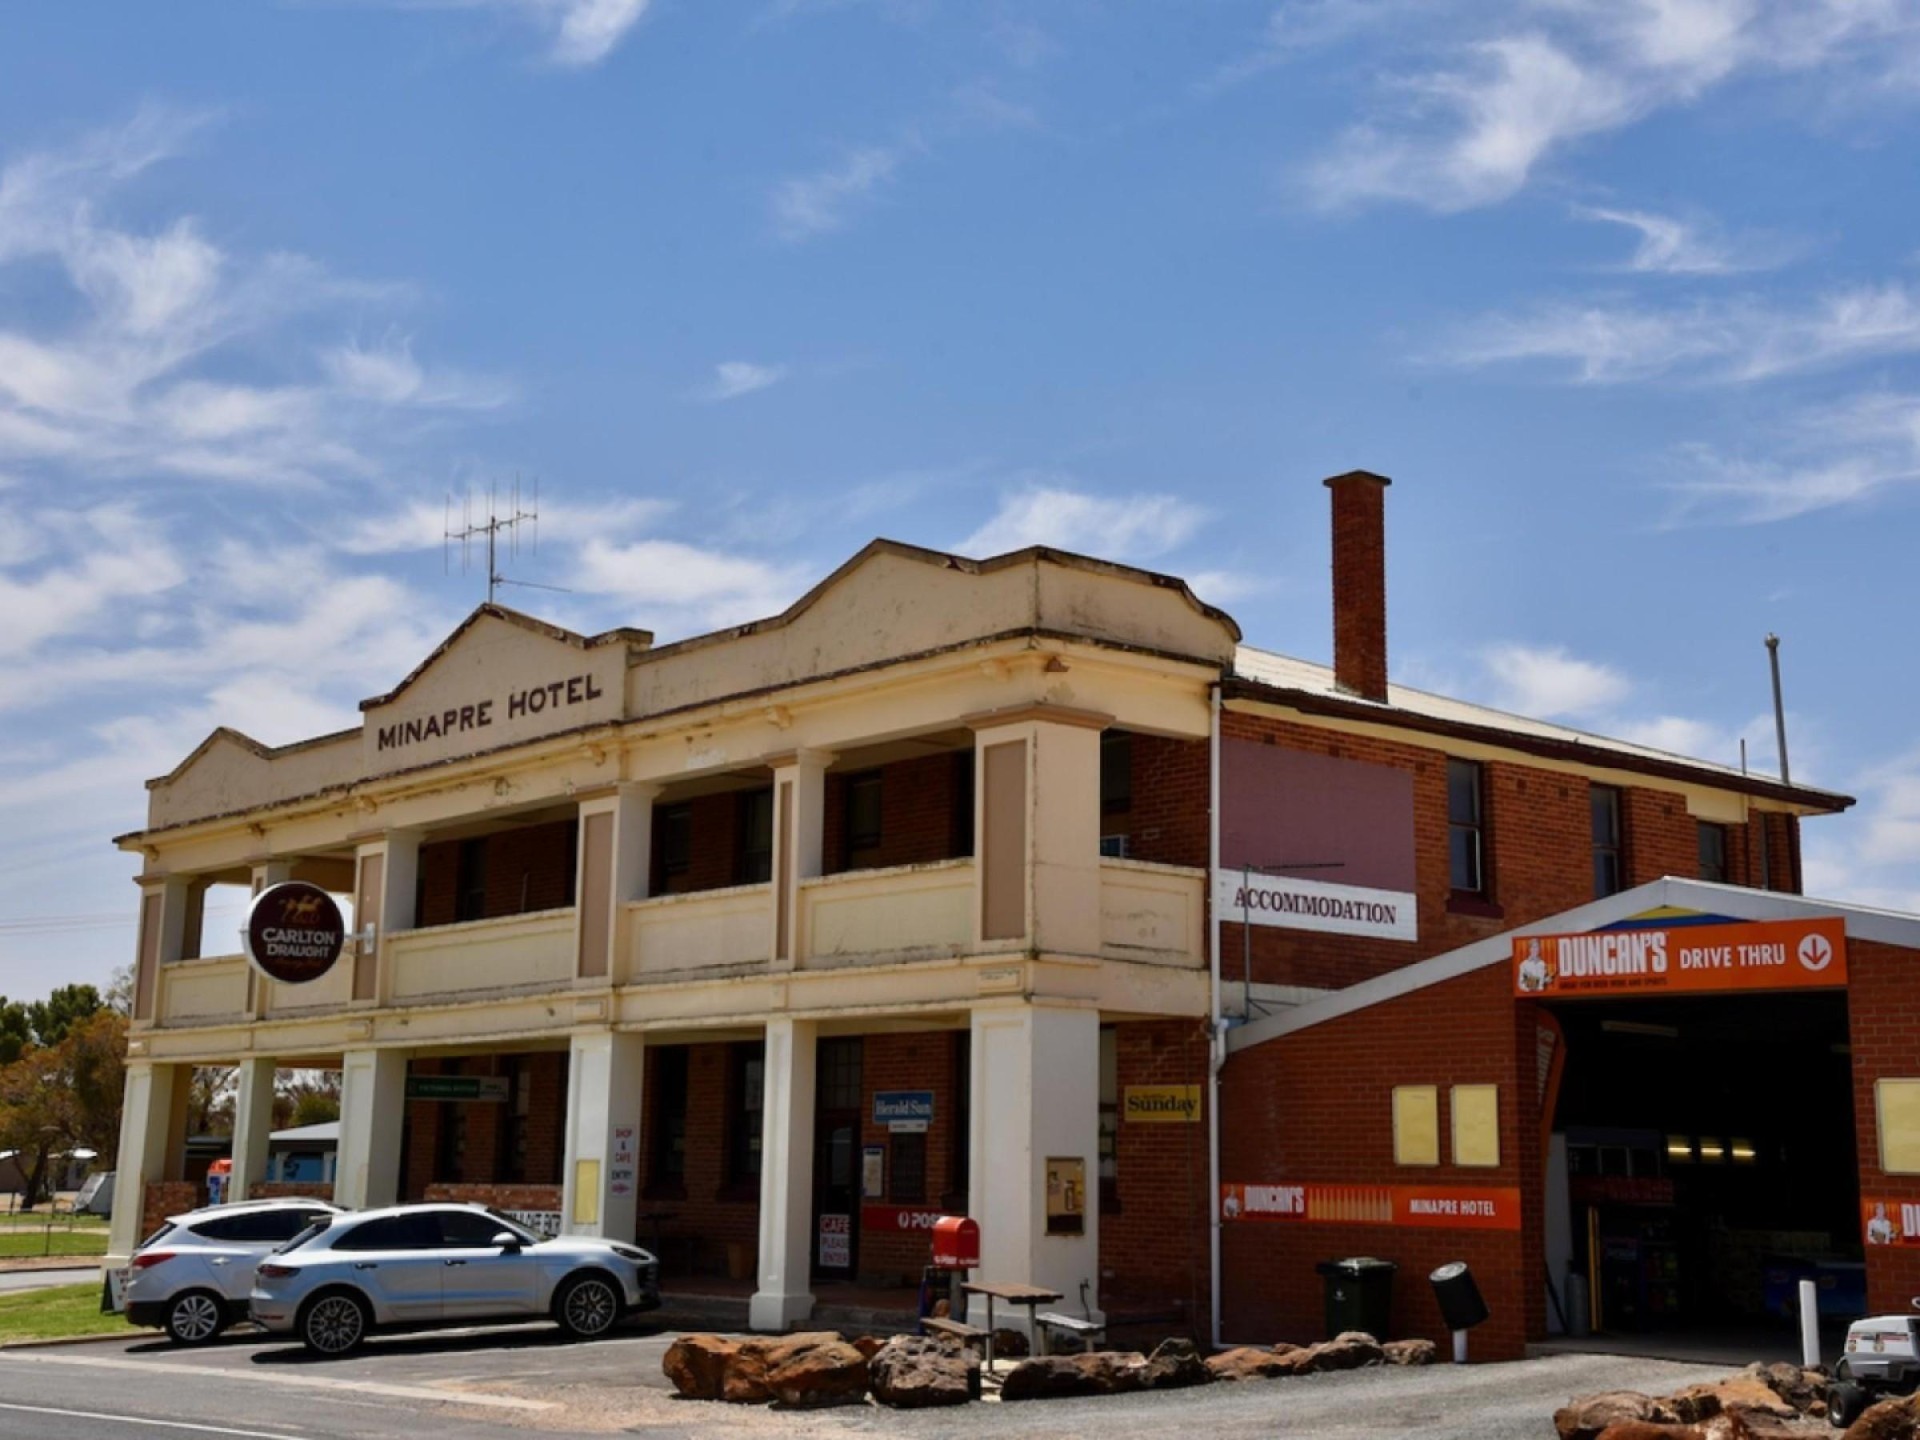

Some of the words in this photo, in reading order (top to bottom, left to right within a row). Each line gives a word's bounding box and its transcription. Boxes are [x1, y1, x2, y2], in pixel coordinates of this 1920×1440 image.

[378, 700, 493, 750] MINAPRE
[508, 673, 603, 719] HOTEL
[1234, 887, 1397, 925] ACCOMMODATION
[262, 927, 335, 945] CARLTON
[266, 943, 330, 958] DRAUGHT
[1558, 931, 1667, 977] DUNCAN'S
[1680, 946, 1732, 969] DRIVE
[1737, 943, 1785, 966] THRU
[876, 1100, 908, 1115] Herald
[911, 1100, 931, 1115] Sun
[1128, 1095, 1197, 1117] Sunday
[1409, 1199, 1458, 1215] MINAPRE
[1461, 1200, 1496, 1217] HOTEL
[822, 1217, 850, 1232] CAFE
